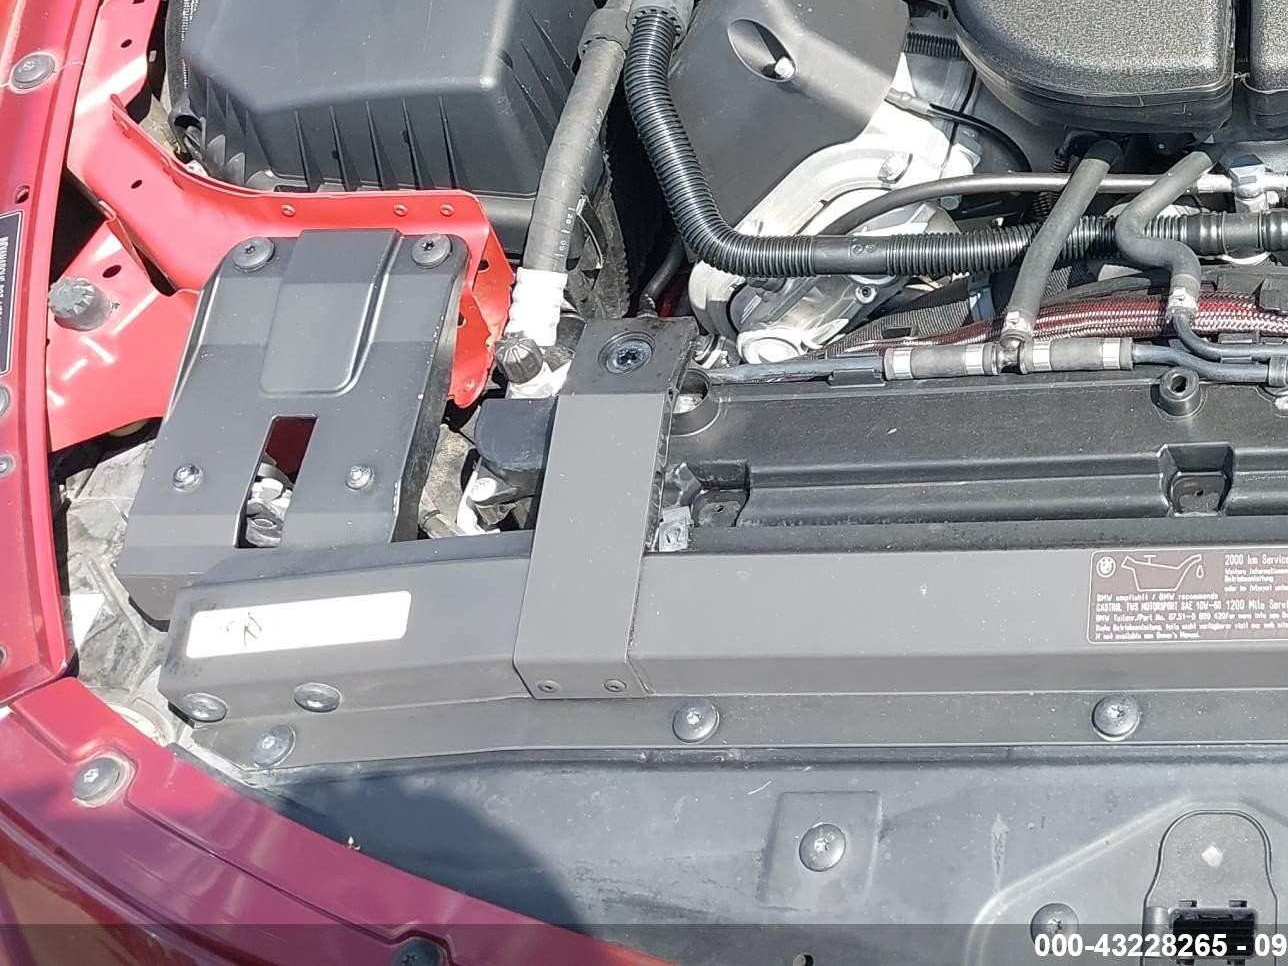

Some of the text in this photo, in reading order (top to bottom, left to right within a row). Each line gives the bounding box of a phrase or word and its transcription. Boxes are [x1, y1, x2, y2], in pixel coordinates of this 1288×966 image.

[1224, 553, 1243, 566] 2000
[1226, 598, 1245, 611] 1200
[1248, 598, 1266, 610] Mile
